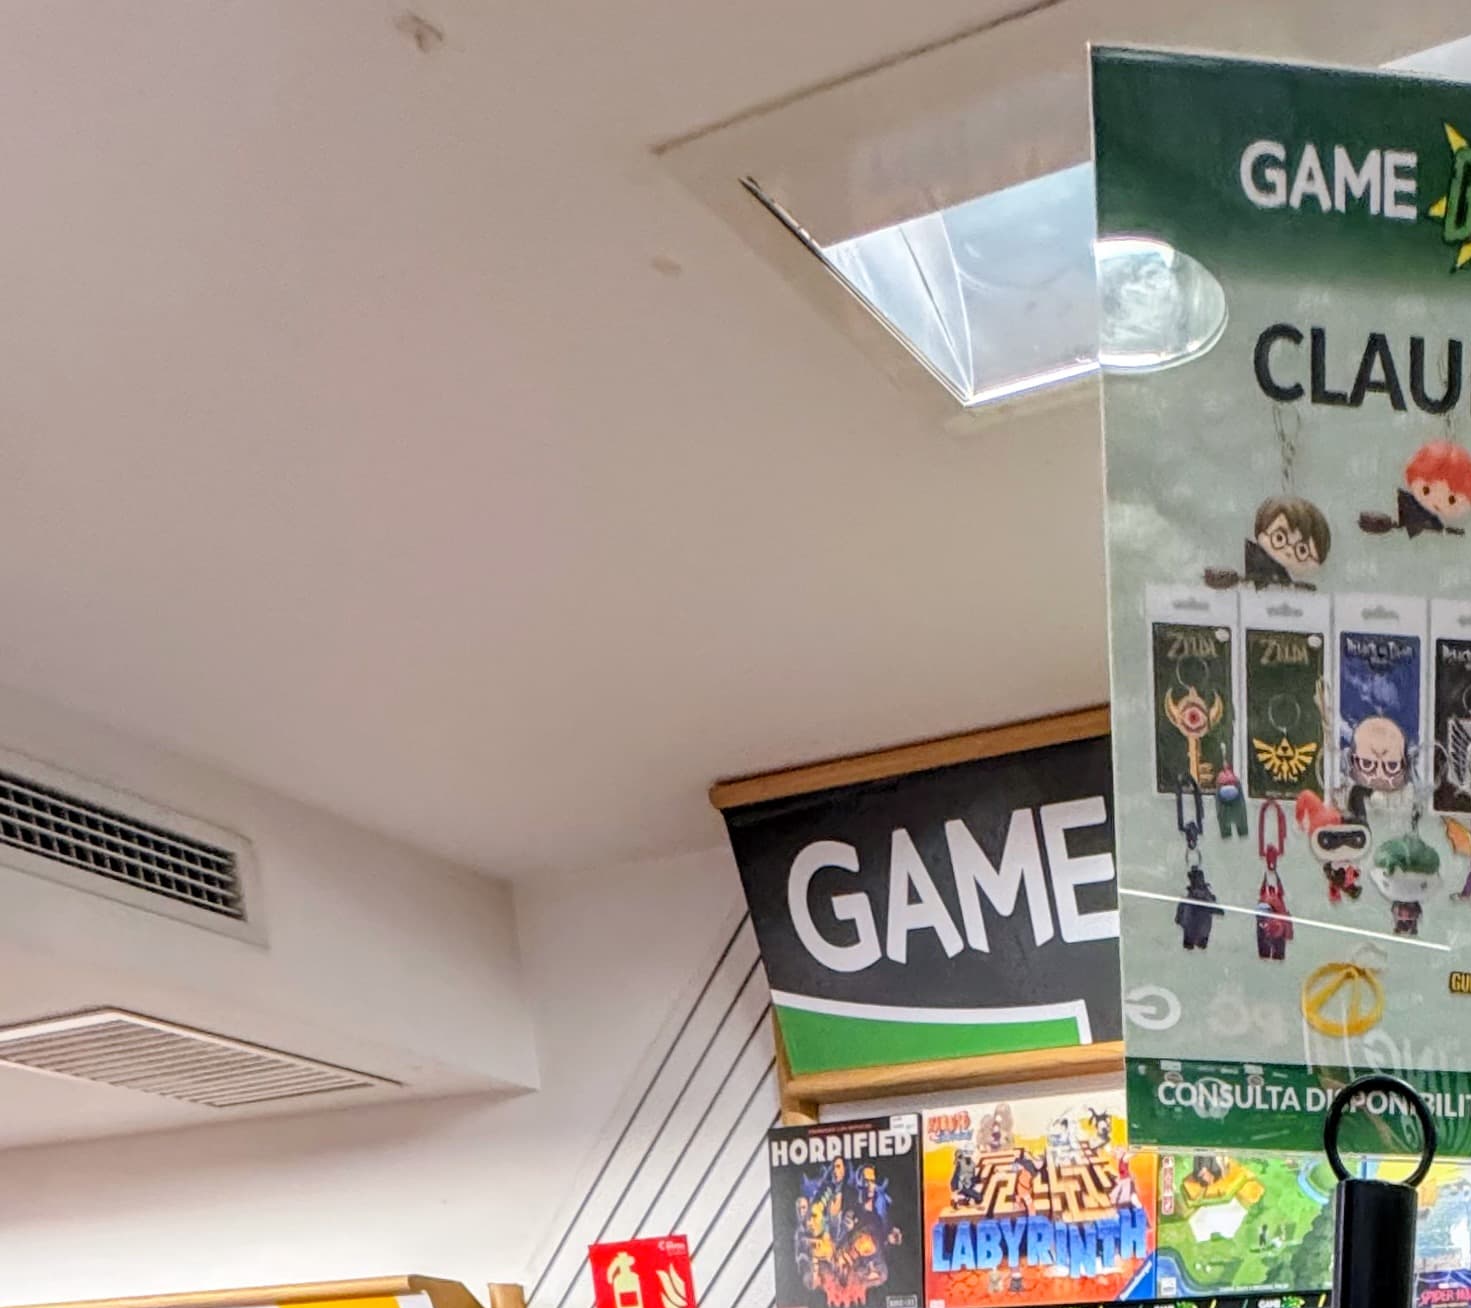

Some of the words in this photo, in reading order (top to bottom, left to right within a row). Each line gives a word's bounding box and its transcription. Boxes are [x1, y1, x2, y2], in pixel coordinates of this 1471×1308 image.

[1239, 139, 1419, 222] GAME
[787, 796, 1120, 973] GAME
[1157, 1081, 1300, 1113] CONSULTA
[771, 1132, 913, 1168] HORRIFIED
[931, 1208, 1148, 1280] LABYRINTH
